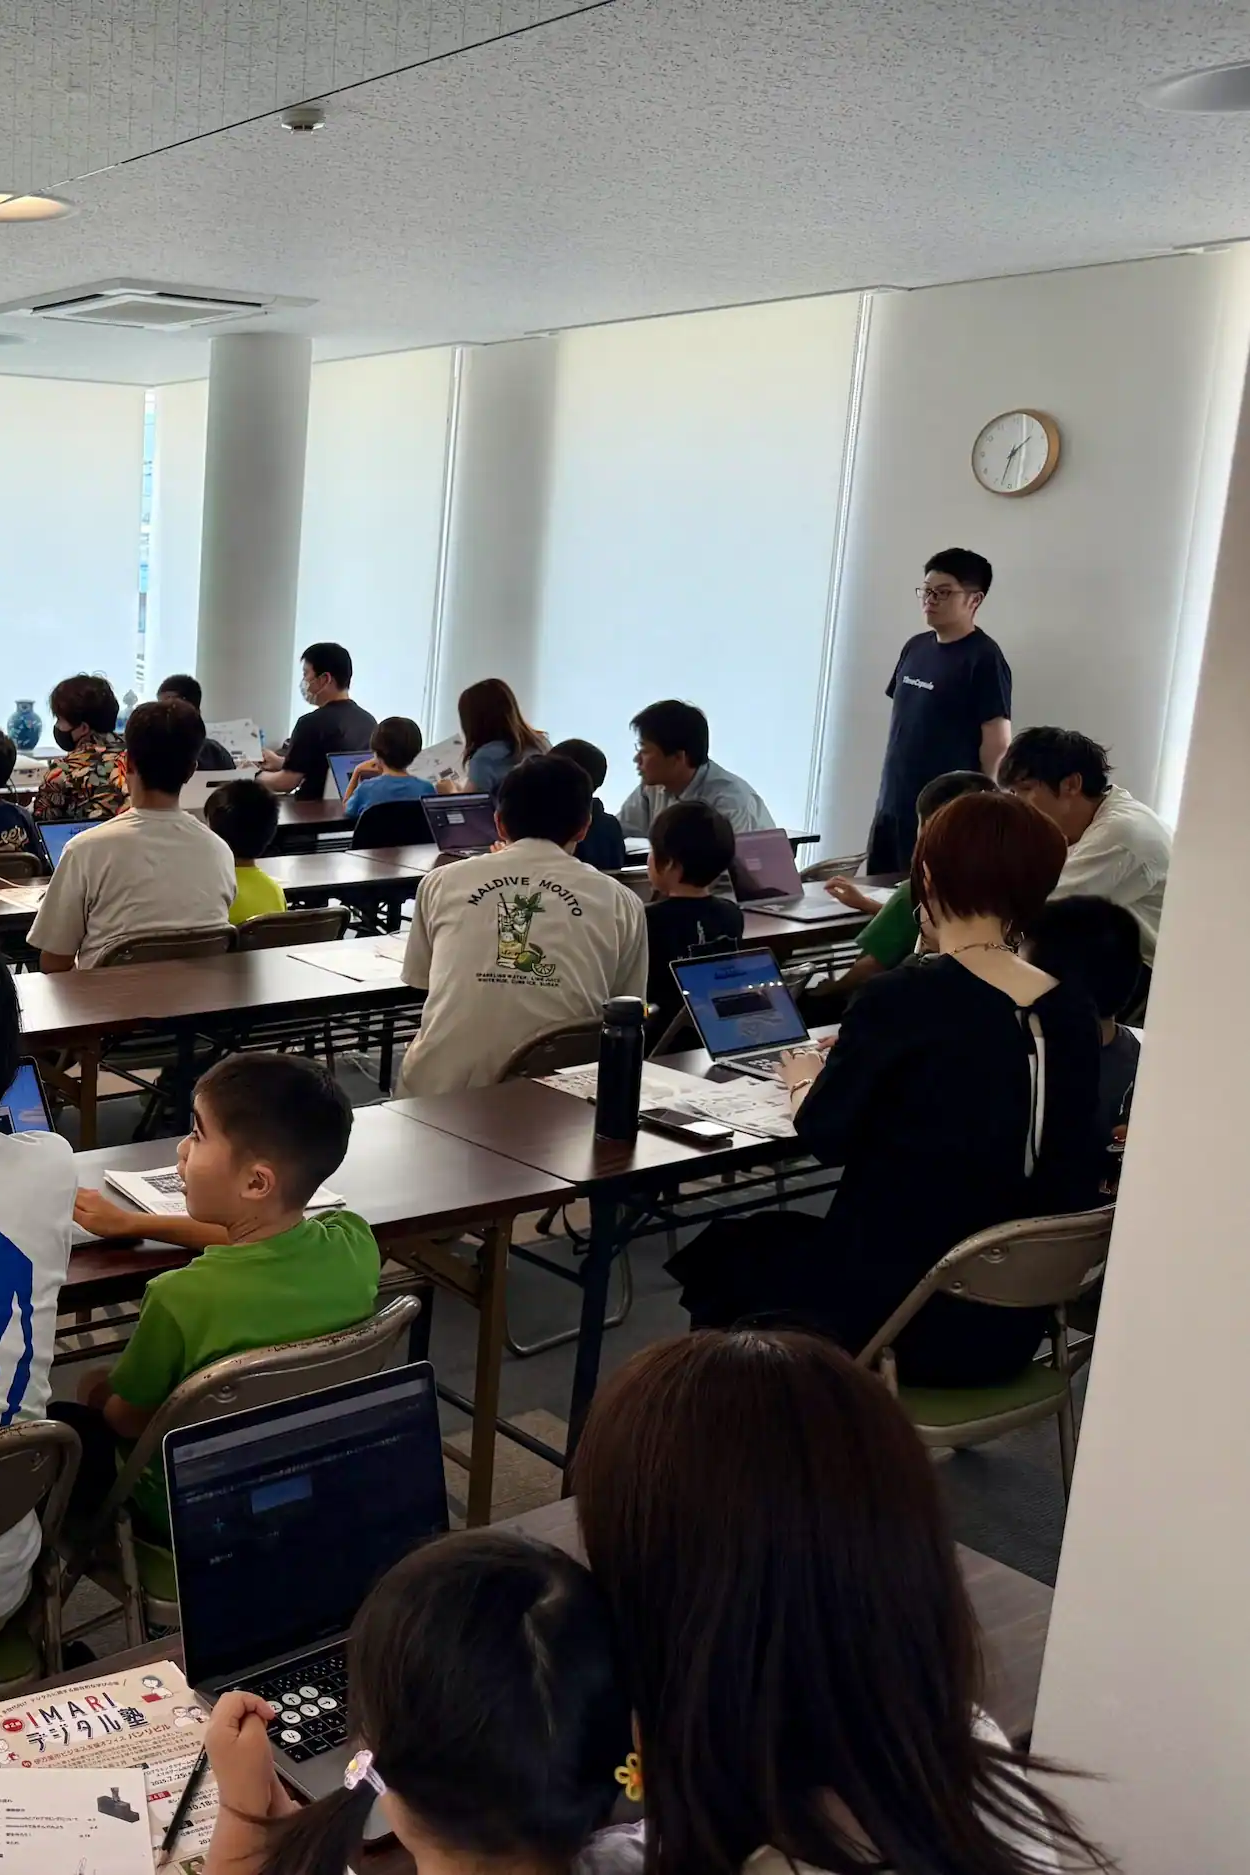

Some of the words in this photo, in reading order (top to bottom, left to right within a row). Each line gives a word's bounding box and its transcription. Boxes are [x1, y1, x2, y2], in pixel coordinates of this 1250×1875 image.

[467, 876, 530, 906] MALDIVE
[538, 879, 584, 917] MOJITO
[26, 1691, 118, 1728] IMARI
[26, 1706, 150, 1753] デジタル塾
